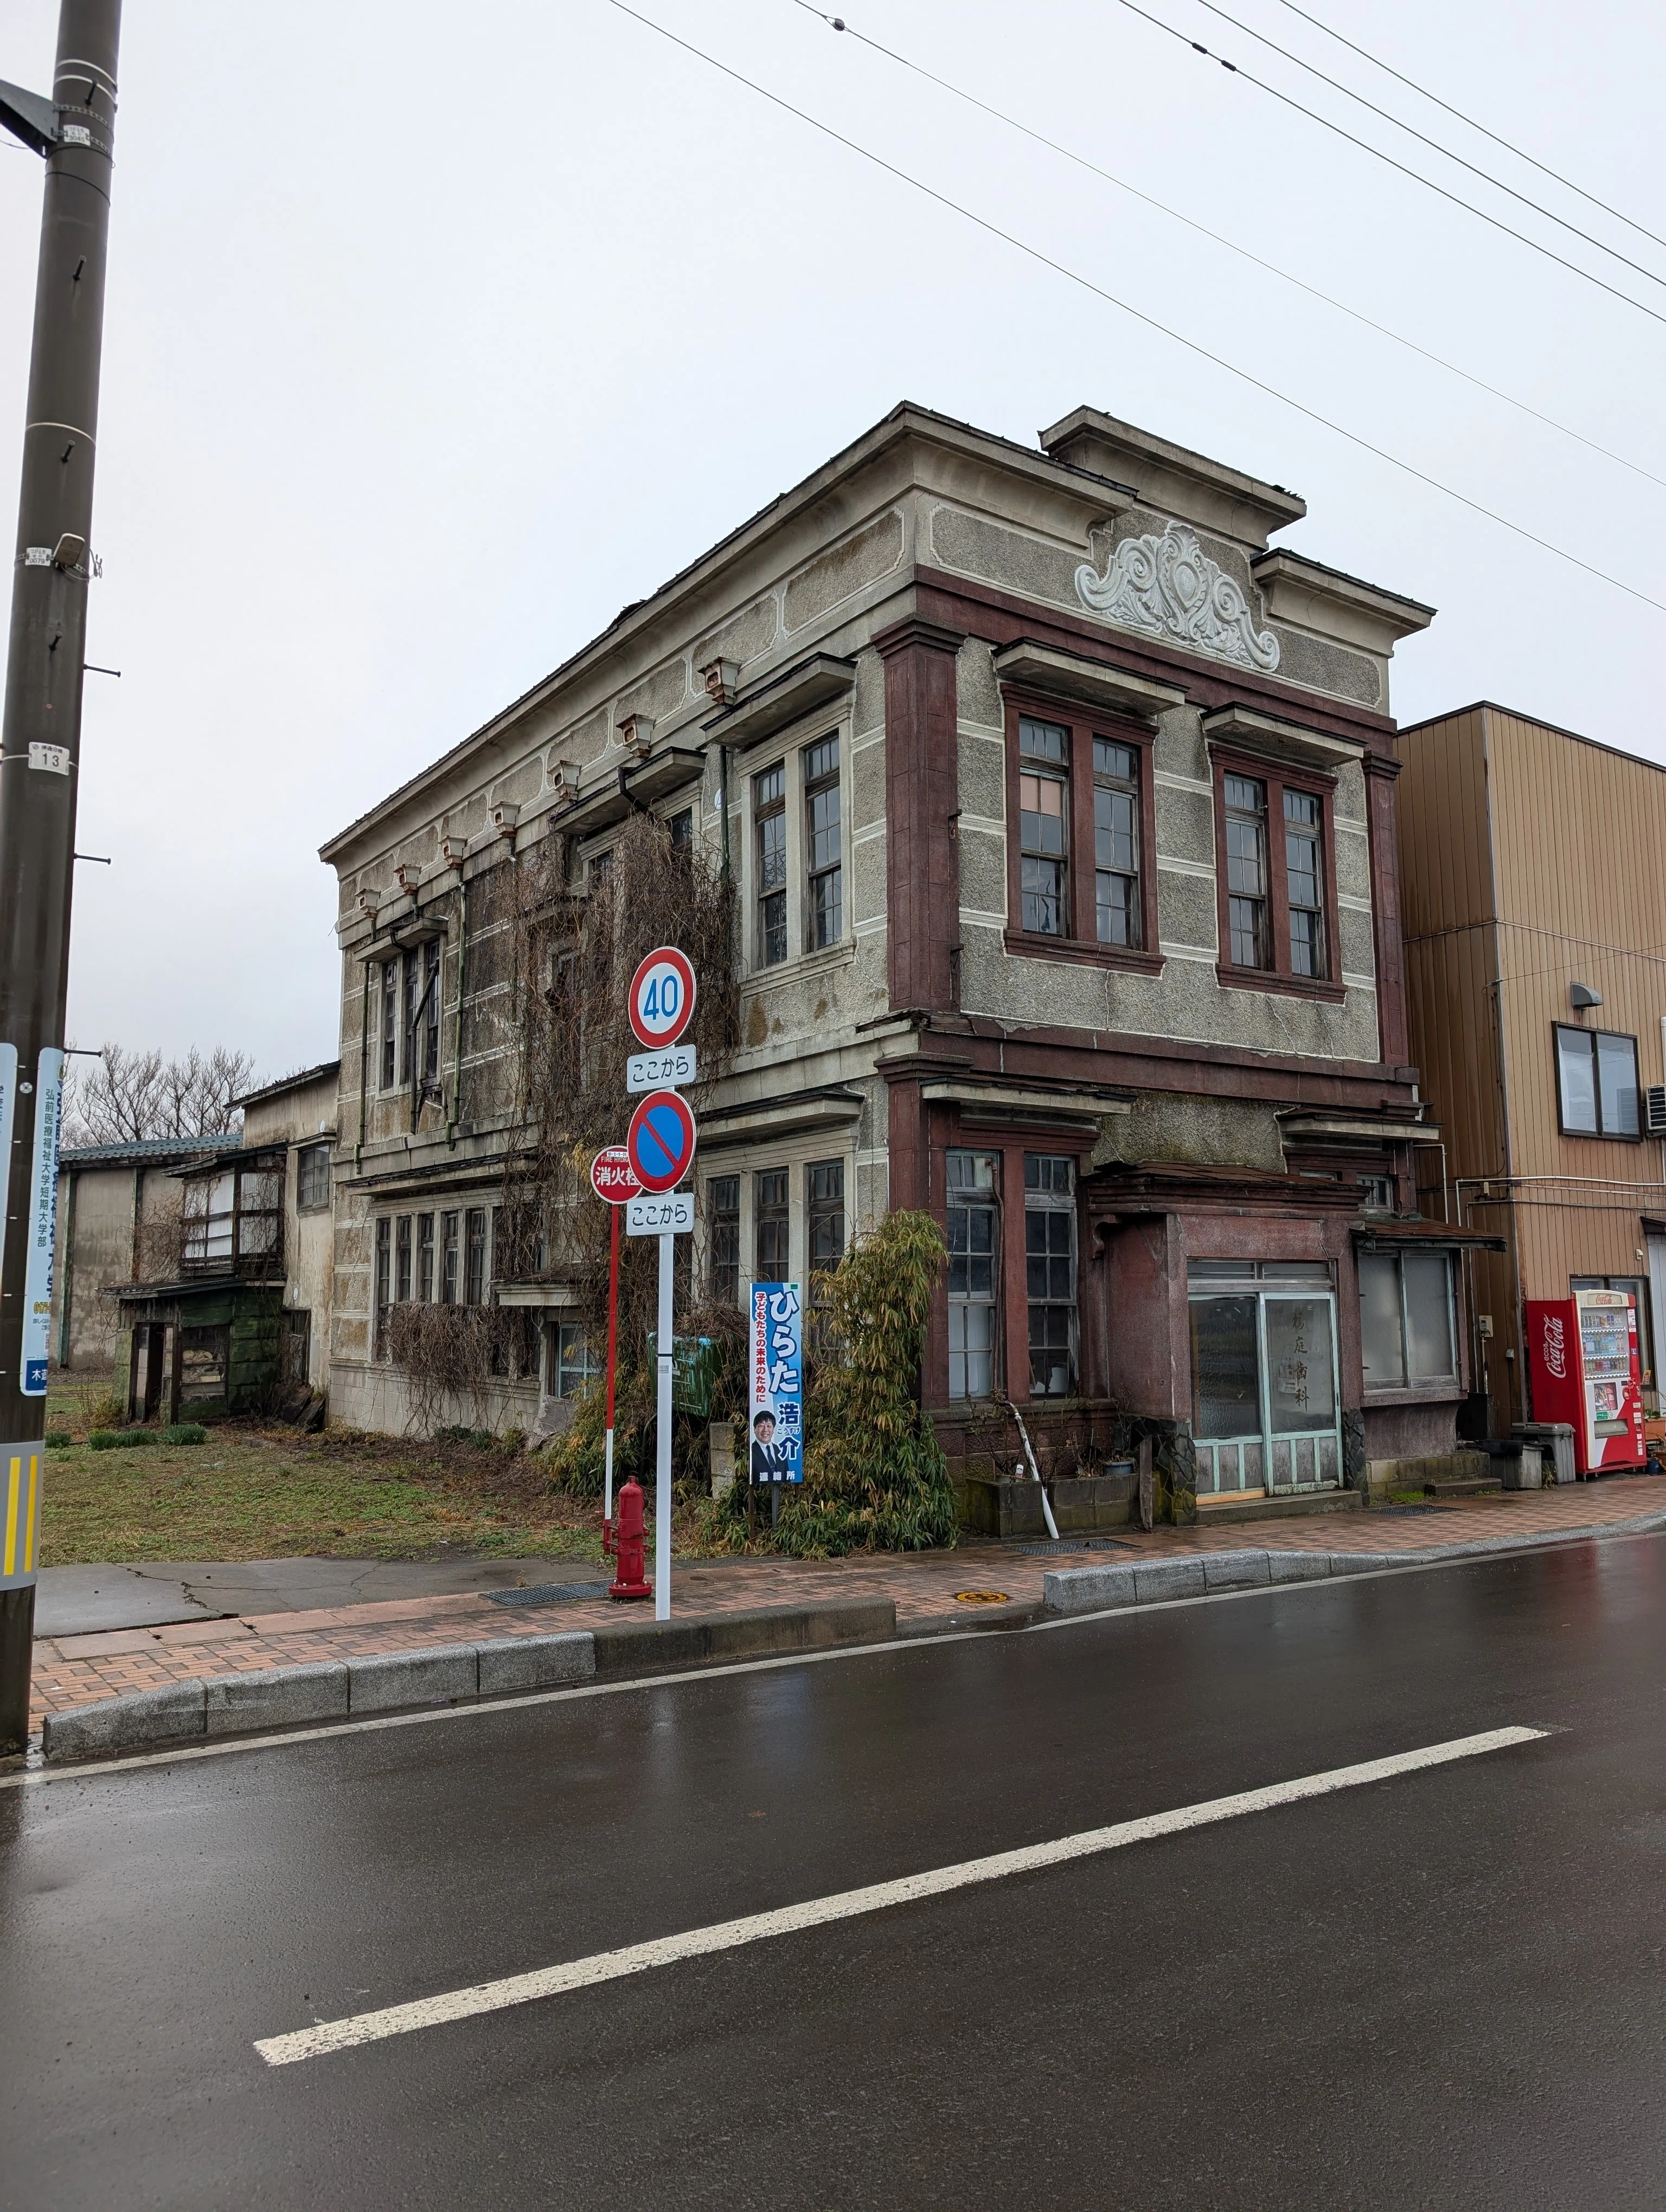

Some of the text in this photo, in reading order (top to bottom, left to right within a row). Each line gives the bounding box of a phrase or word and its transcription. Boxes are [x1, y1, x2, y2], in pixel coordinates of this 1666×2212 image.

[42, 753, 59, 767] 13
[643, 974, 678, 1020] 40
[632, 1056, 689, 1083] ここから
[37, 1089, 54, 1248] 弘前医療福祉大学短期大学部
[631, 1204, 688, 1227] ここから
[755, 1292, 766, 1403] 子どもたちの未来のために
[767, 1290, 801, 1461] ひらた 浩介
[777, 1426, 801, 1436] こうすけ
[759, 1471, 796, 1482] 連絡所
